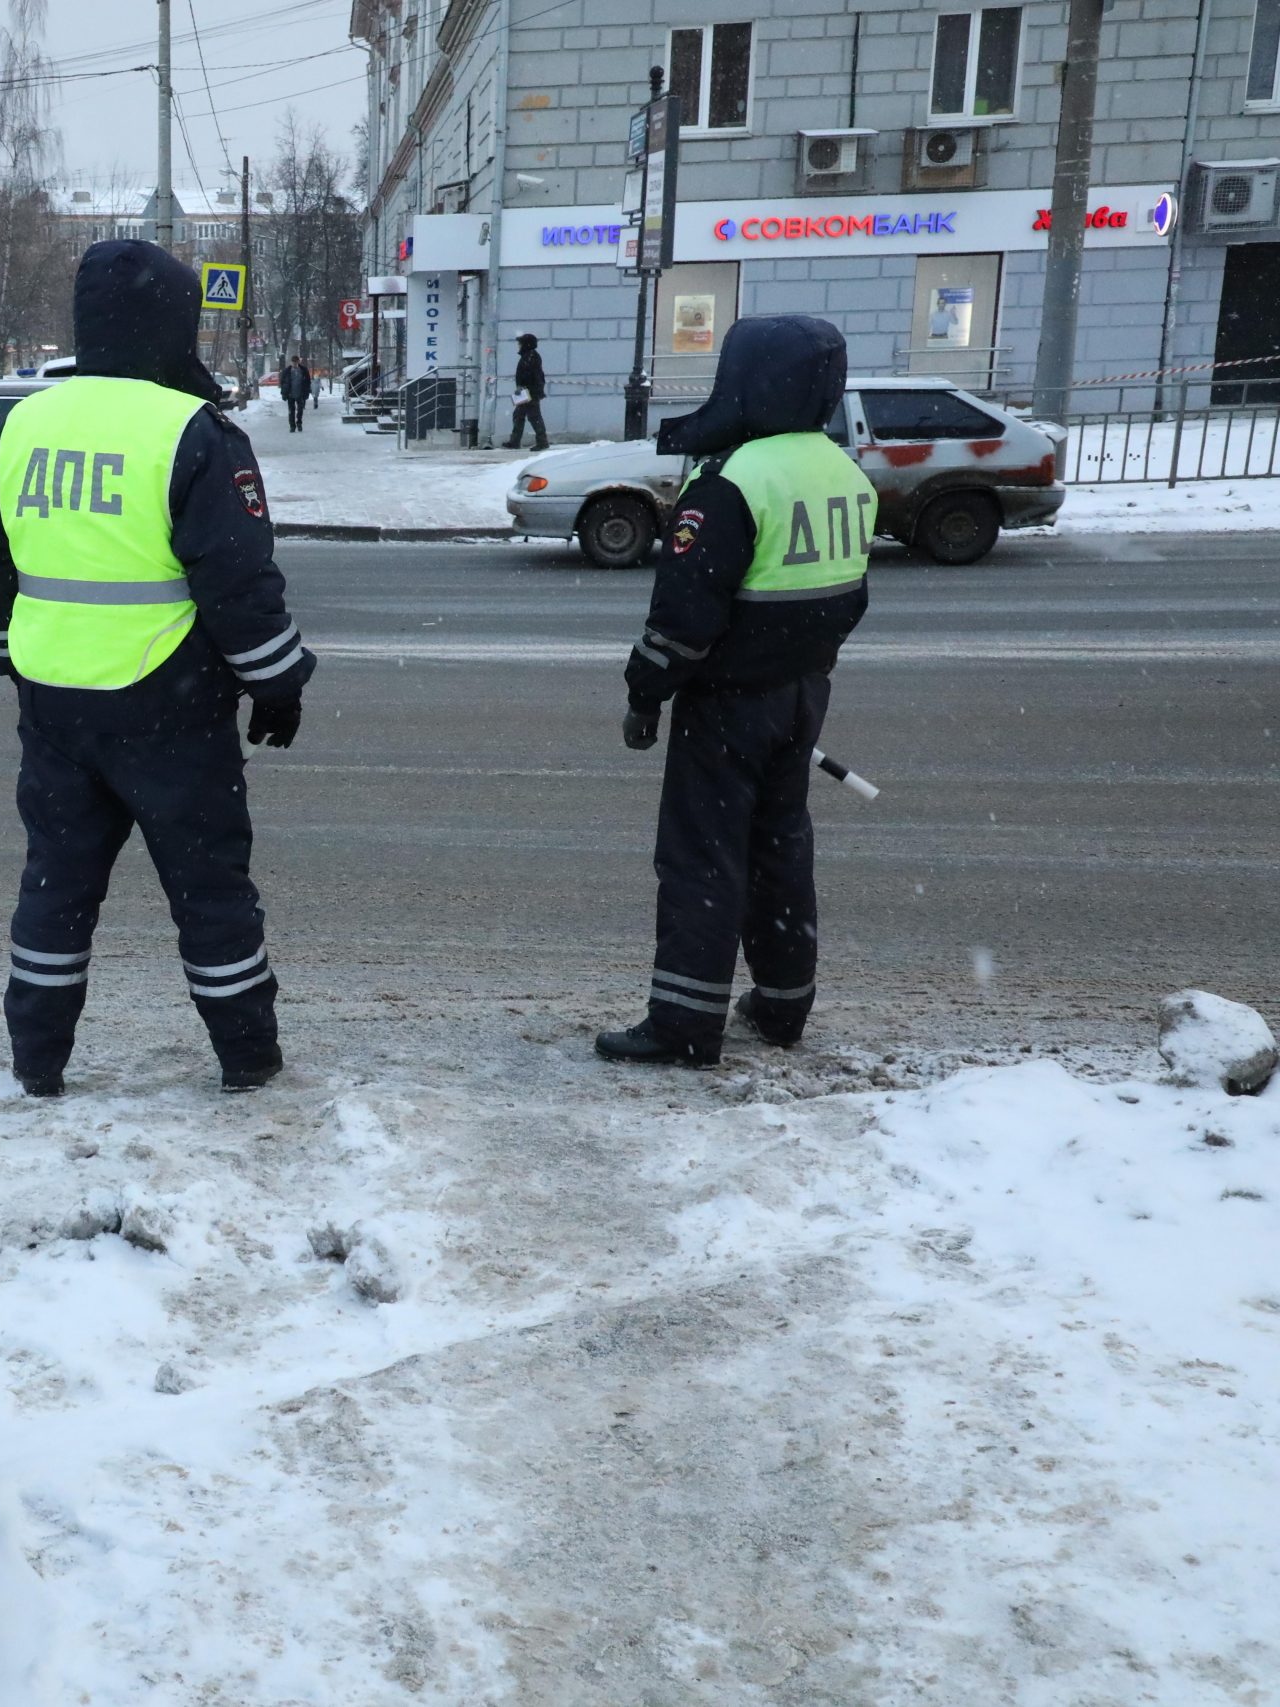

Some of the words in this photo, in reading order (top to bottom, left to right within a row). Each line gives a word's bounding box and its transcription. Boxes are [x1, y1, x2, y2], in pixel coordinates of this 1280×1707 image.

[542, 224, 620, 247] ИПОТЕ
[741, 211, 957, 241] СОВКОМБАНК
[1032, 206, 1128, 231] Хва
[425, 279, 440, 375] ИПОТЕКА
[16, 447, 125, 519] ДПС
[782, 493, 871, 566] ДПС
